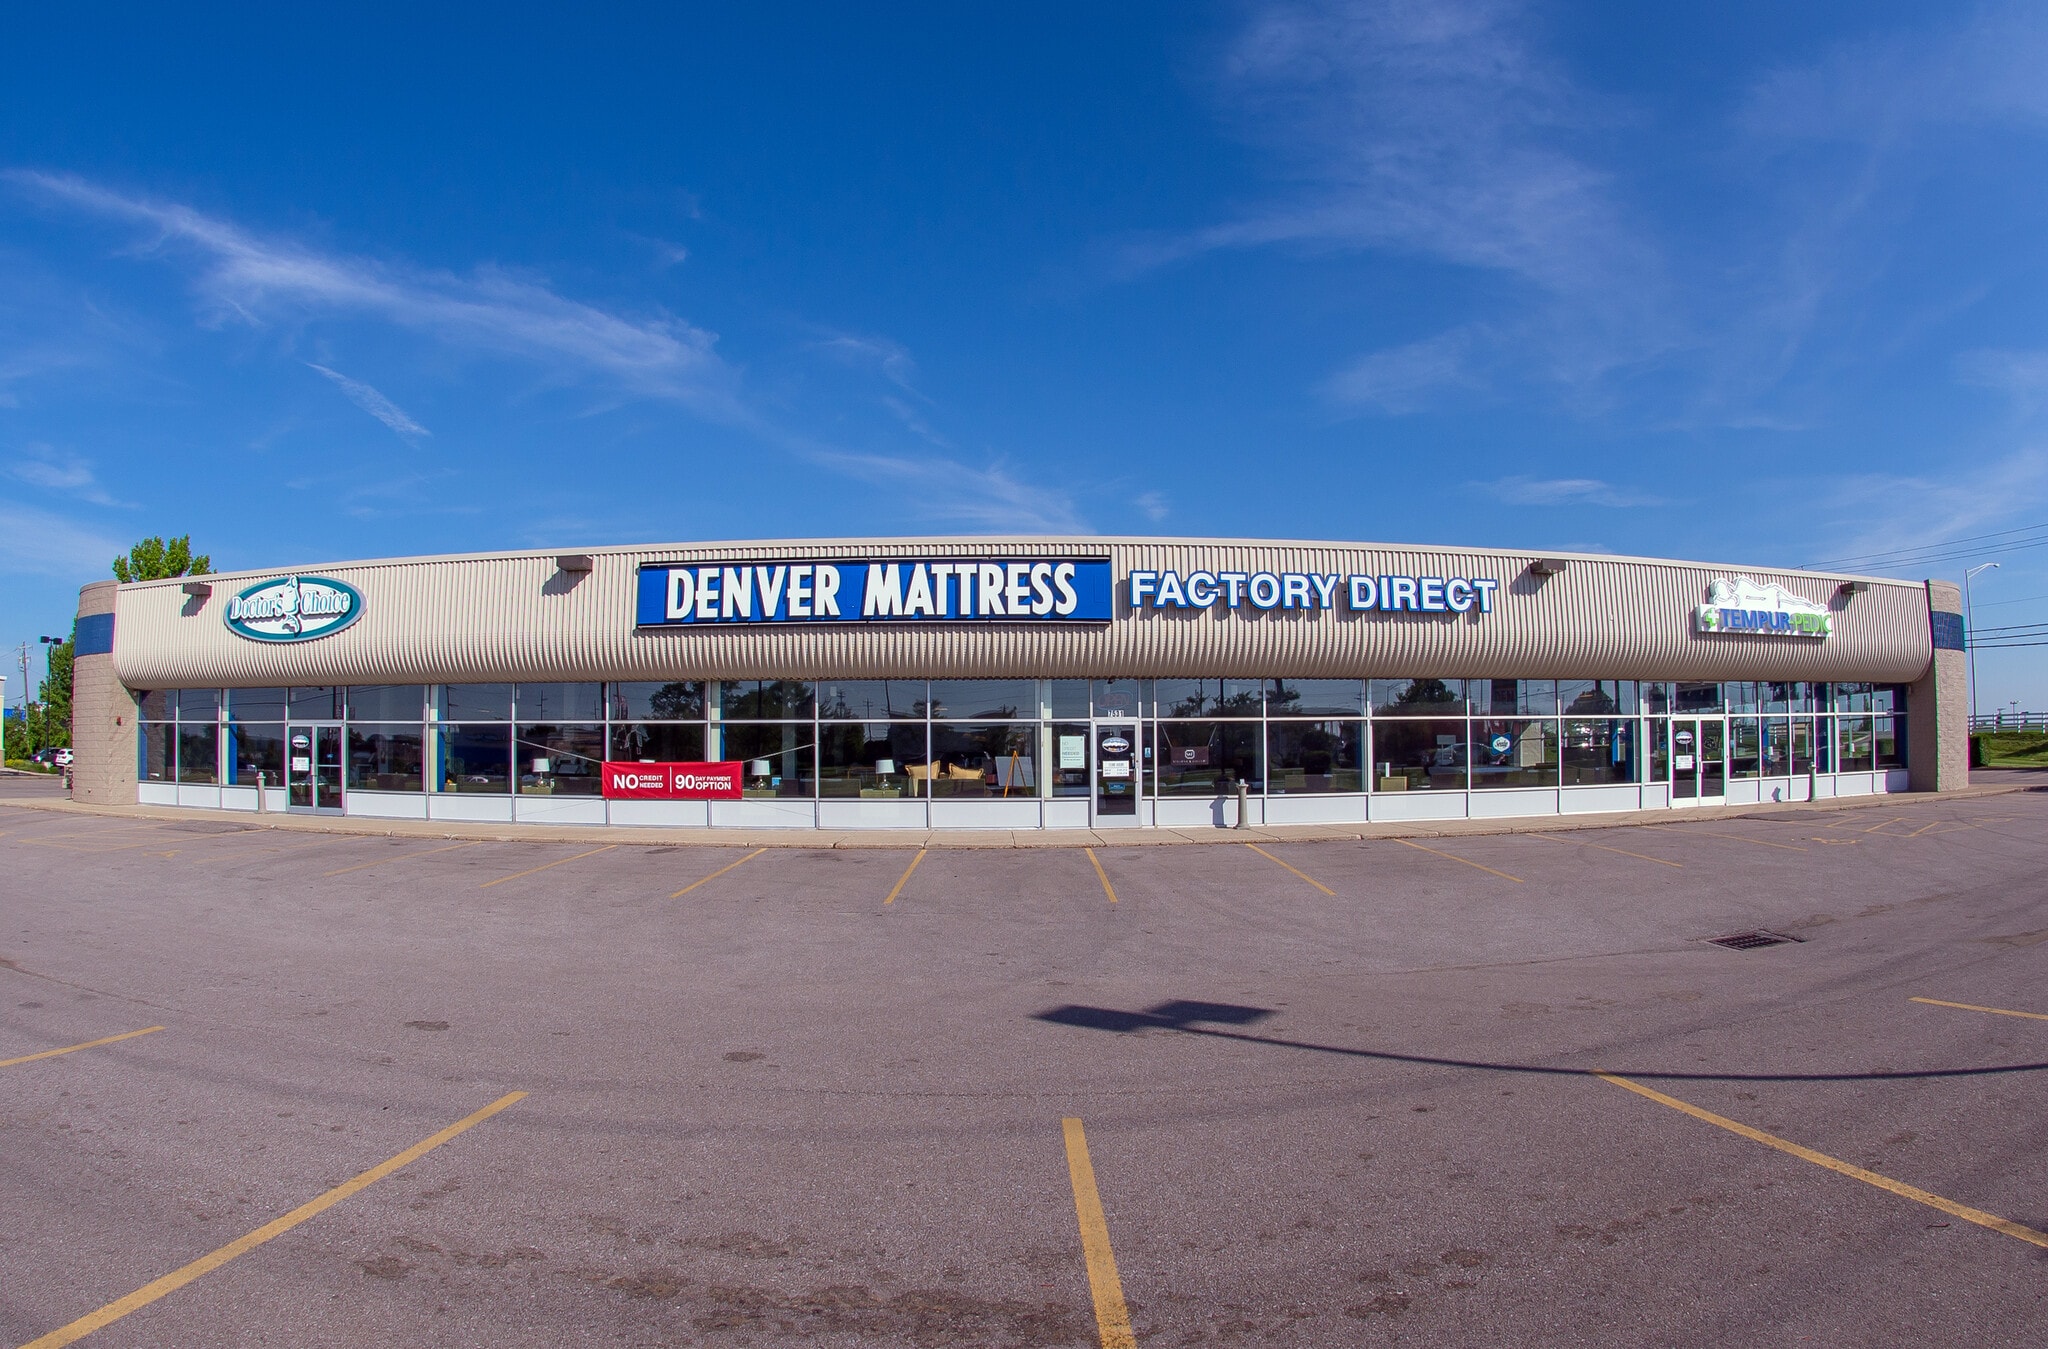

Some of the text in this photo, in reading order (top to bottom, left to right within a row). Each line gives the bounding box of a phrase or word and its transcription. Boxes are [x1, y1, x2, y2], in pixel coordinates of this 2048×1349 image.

[667, 563, 1078, 619] DENVER MATTRESS
[1129, 570, 1498, 613] FACTORY DIRECT
[230, 590, 351, 619] Doctor's Choice
[613, 774, 639, 789] NO
[675, 774, 695, 790] 90
[695, 781, 732, 790] OPTION
